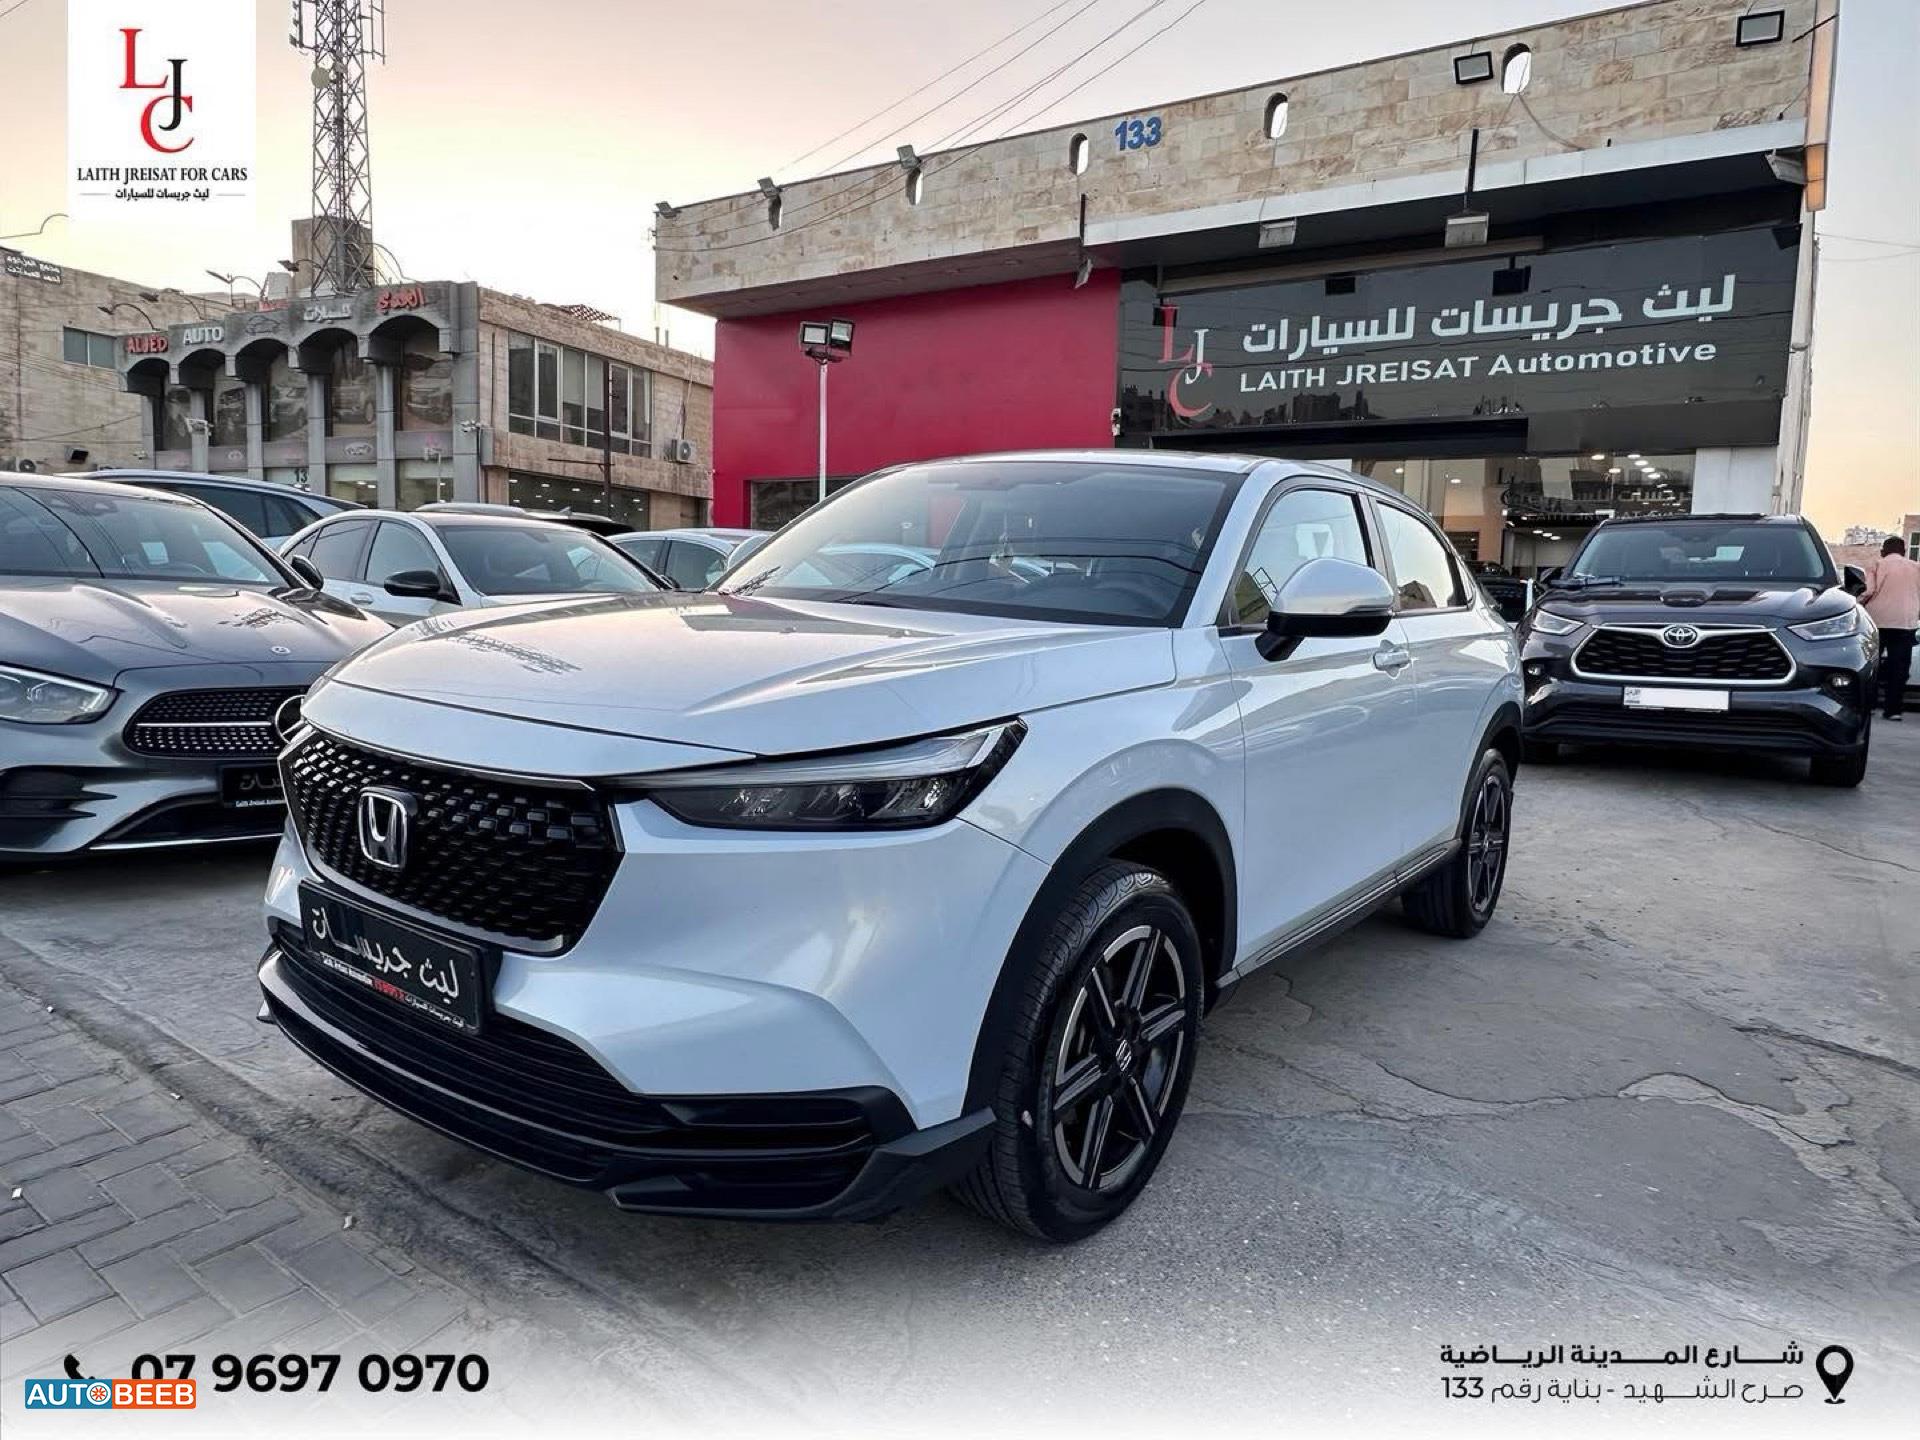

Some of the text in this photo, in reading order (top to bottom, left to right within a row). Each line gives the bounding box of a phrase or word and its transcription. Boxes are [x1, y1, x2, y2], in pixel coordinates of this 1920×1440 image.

[1115, 116, 1162, 151] 133
[182, 326, 225, 345] AUTO
[1242, 274, 1736, 361] ليث جريسات للسيارات
[1239, 342, 1717, 393] LAITH JREISAT Automotive
[312, 907, 412, 979] جريسات
[418, 958, 460, 1004] ليث
